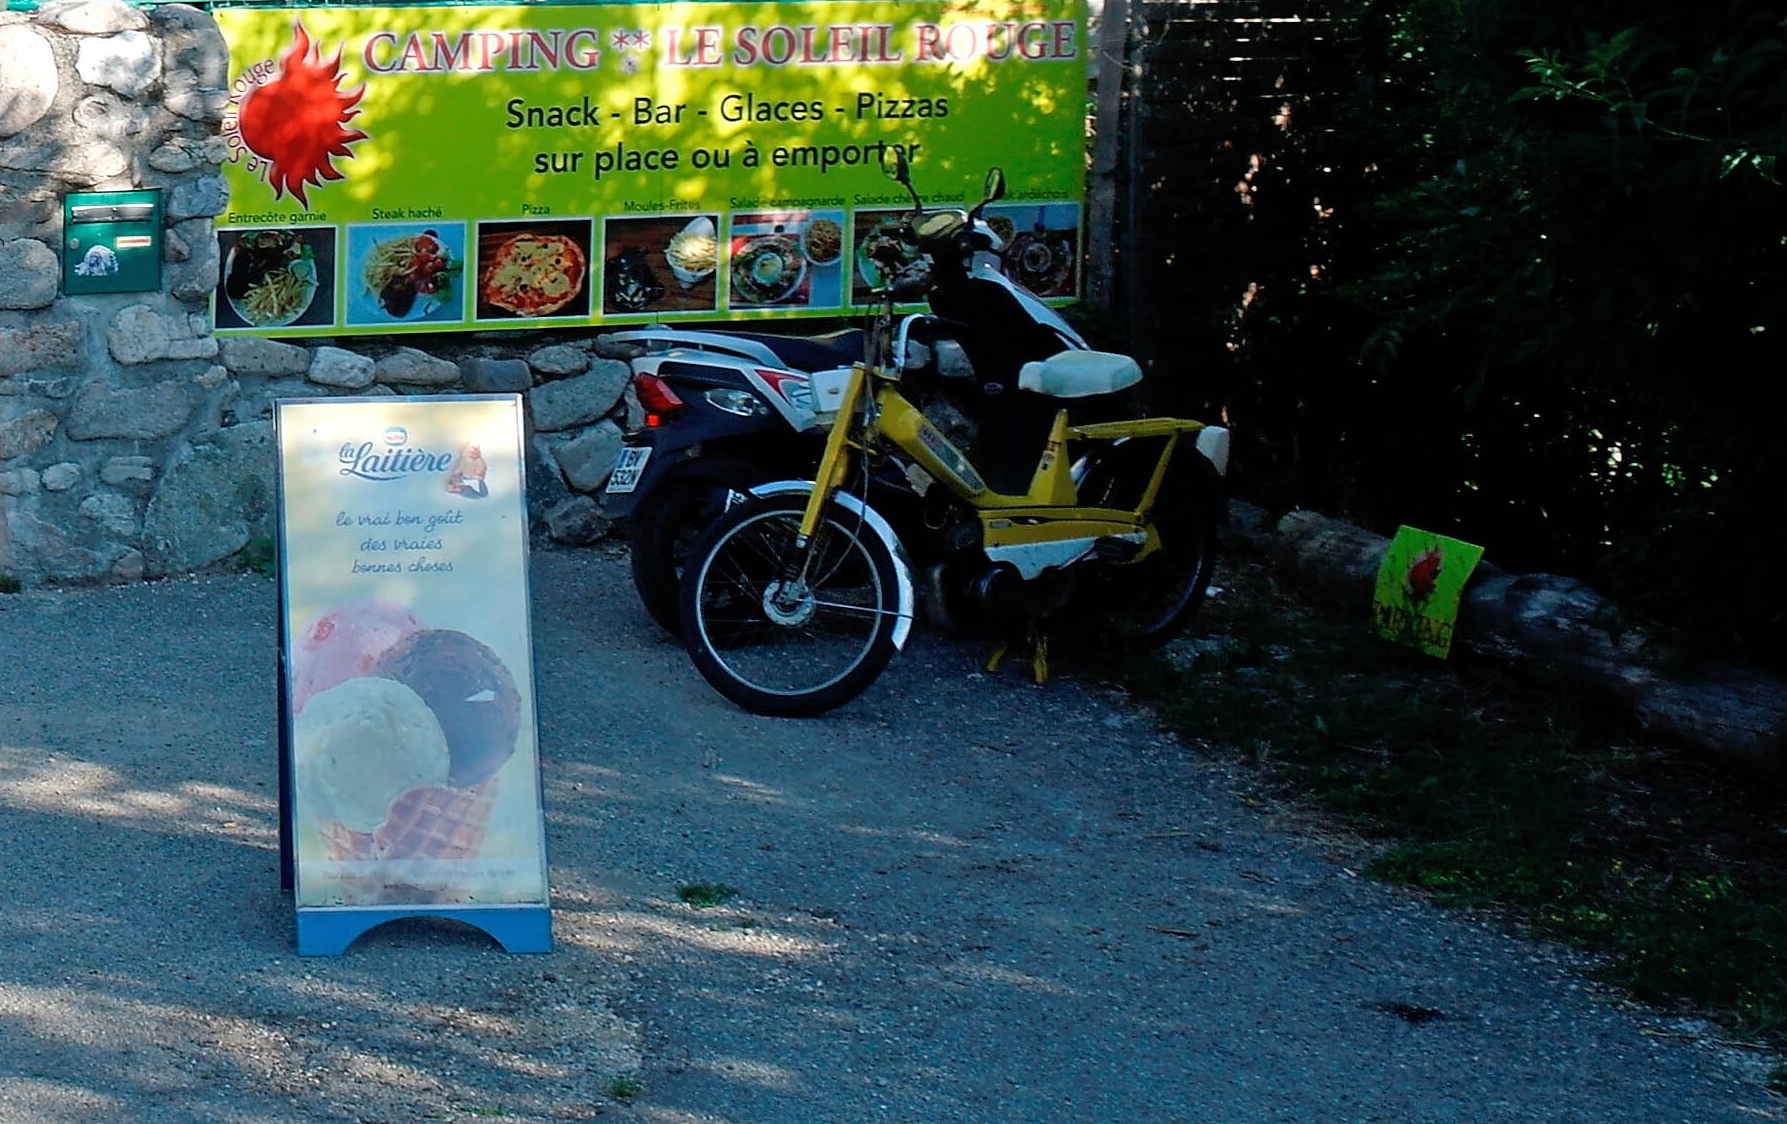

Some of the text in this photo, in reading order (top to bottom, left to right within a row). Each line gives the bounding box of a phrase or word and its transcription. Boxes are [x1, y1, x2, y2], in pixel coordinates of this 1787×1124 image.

[364, 21, 1078, 72] CAMPING LE SOLEIL ROUGE
[506, 96, 600, 128] Snack
[634, 97, 687, 125] Bar
[720, 92, 825, 123] Glaces
[856, 92, 949, 121] Pizzas
[534, 151, 583, 174] sur
[594, 141, 679, 180] place
[691, 146, 730, 169] ou
[742, 140, 759, 168] à
[372, 207, 442, 219] Steak haché
[522, 204, 550, 215] Pizza
[624, 199, 701, 212] Moules-Frites
[228, 211, 327, 226] Entrecôte garnie
[339, 441, 453, 481] Laitière
[335, 509, 464, 533] le vrai bon goût
[360, 537, 443, 552] des vraies
[350, 555, 454, 574] bonnes choses
